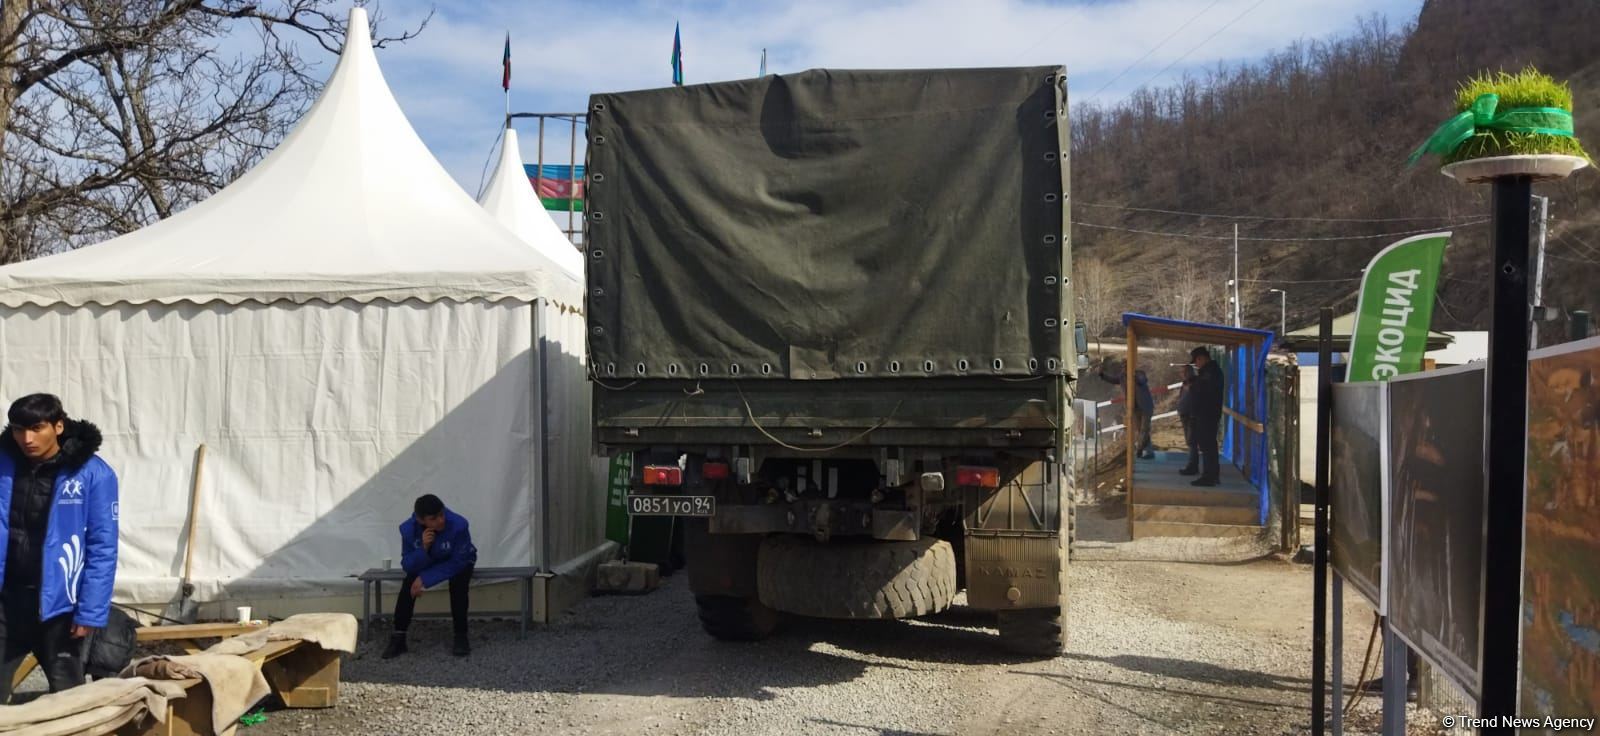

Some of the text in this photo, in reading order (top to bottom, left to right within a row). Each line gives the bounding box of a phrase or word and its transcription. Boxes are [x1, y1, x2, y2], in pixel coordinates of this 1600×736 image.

[1372, 268, 1422, 380] ЭКОЦИД
[694, 497, 710, 510] 94
[978, 565, 1047, 579] KAMAZ
